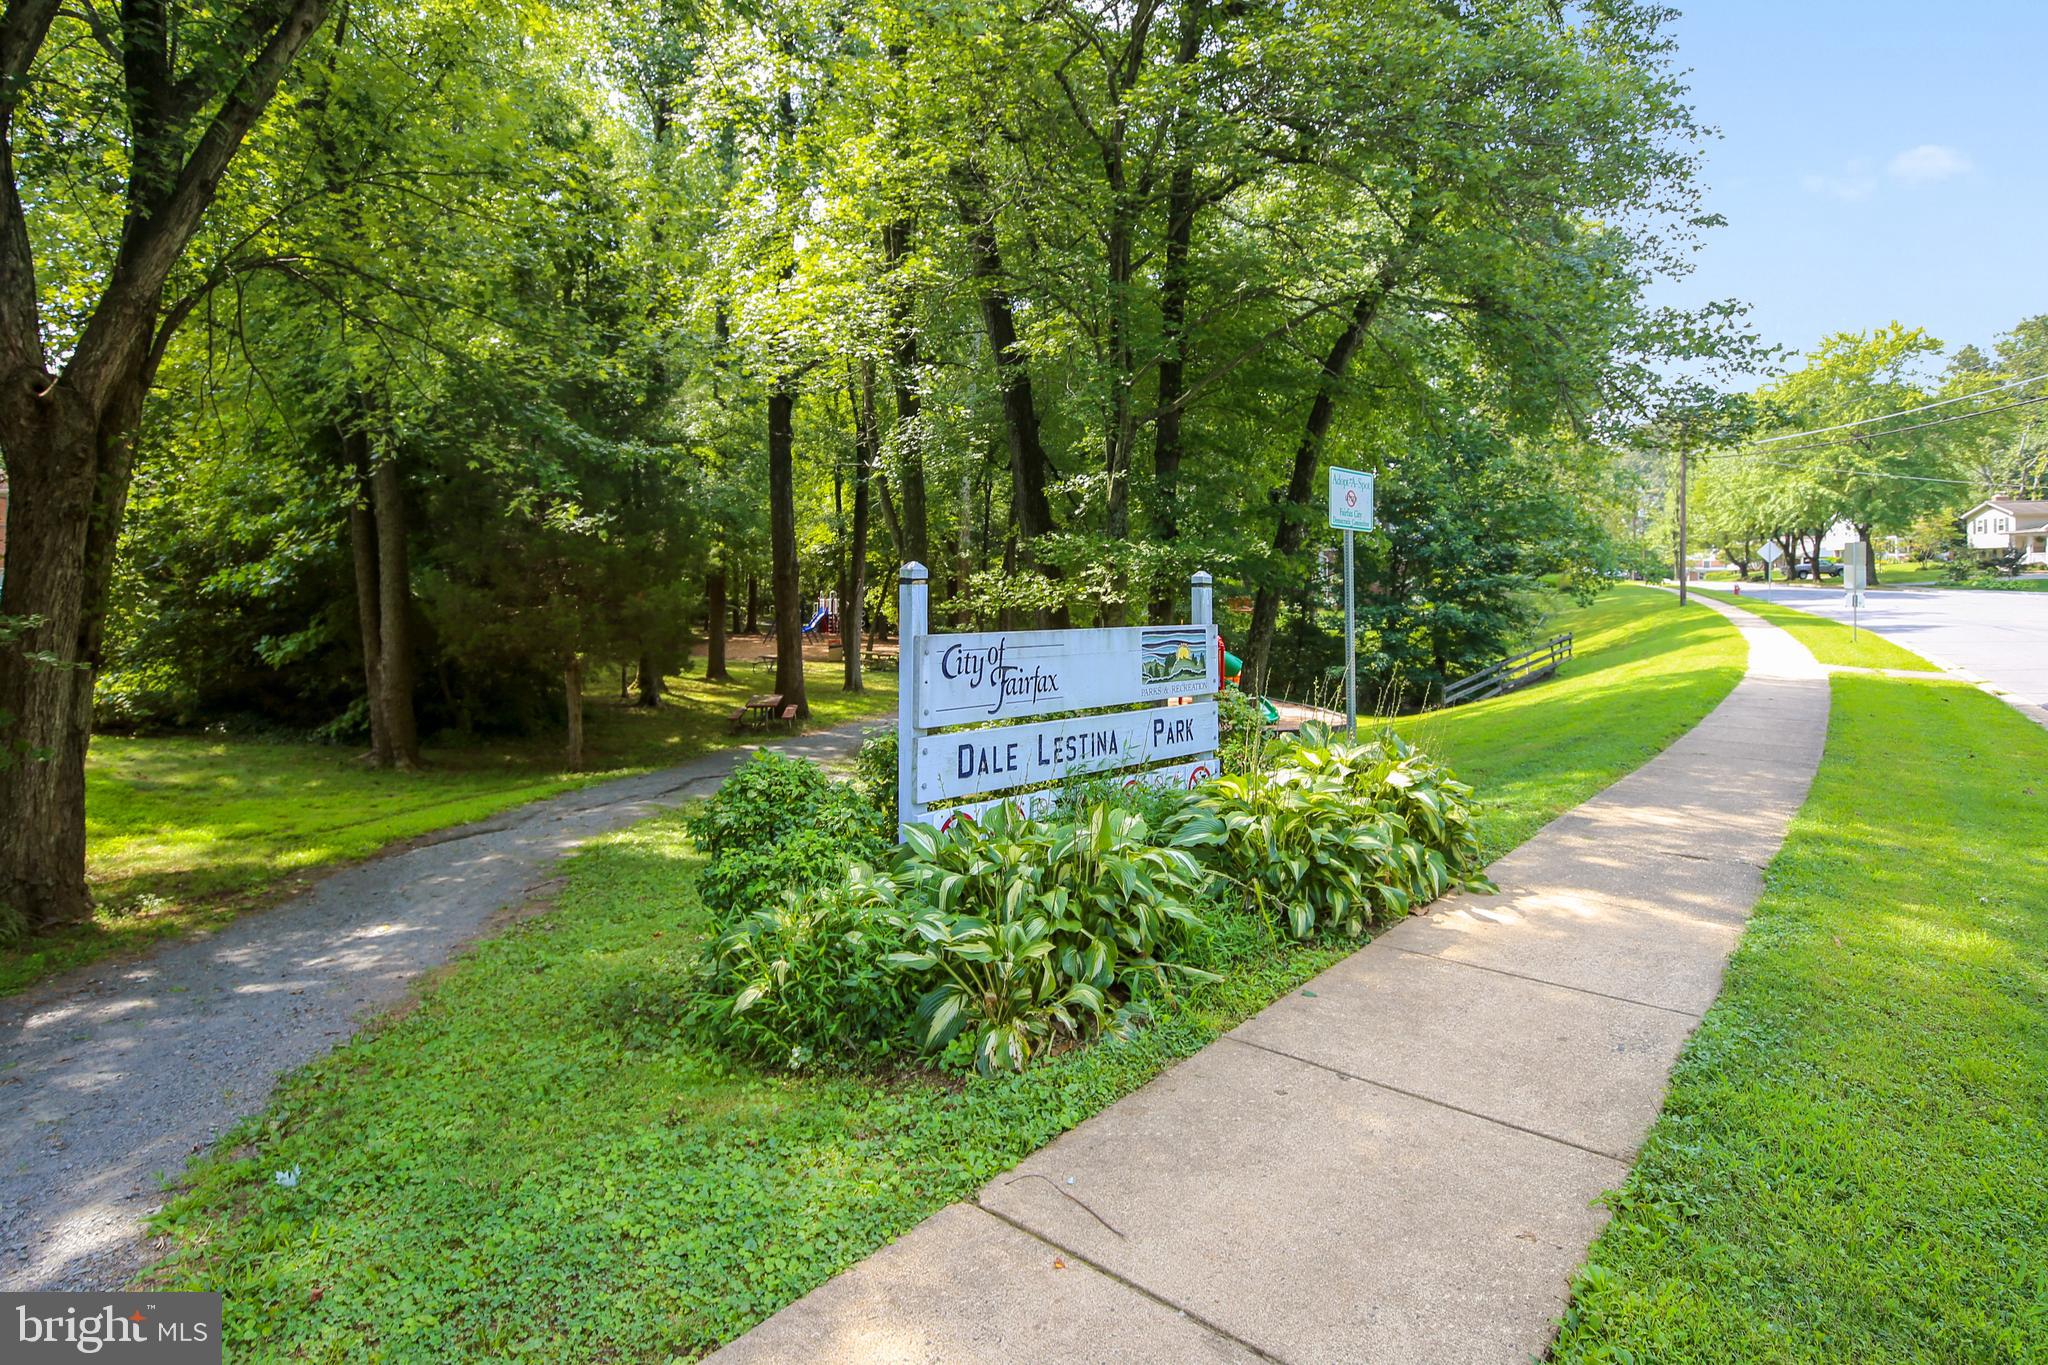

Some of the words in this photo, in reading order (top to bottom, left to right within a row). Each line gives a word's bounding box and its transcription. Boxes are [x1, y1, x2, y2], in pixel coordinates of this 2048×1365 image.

[941, 643, 984, 689] City
[987, 637, 1005, 679] of
[987, 665, 1059, 715] Fairfax
[1141, 687, 1161, 697] PARKS
[1163, 685, 1169, 694] &
[1171, 682, 1208, 693] RECREATION
[958, 743, 1018, 779] DALE
[1037, 730, 1118, 766] LESTINA
[1153, 718, 1194, 747] PARK
